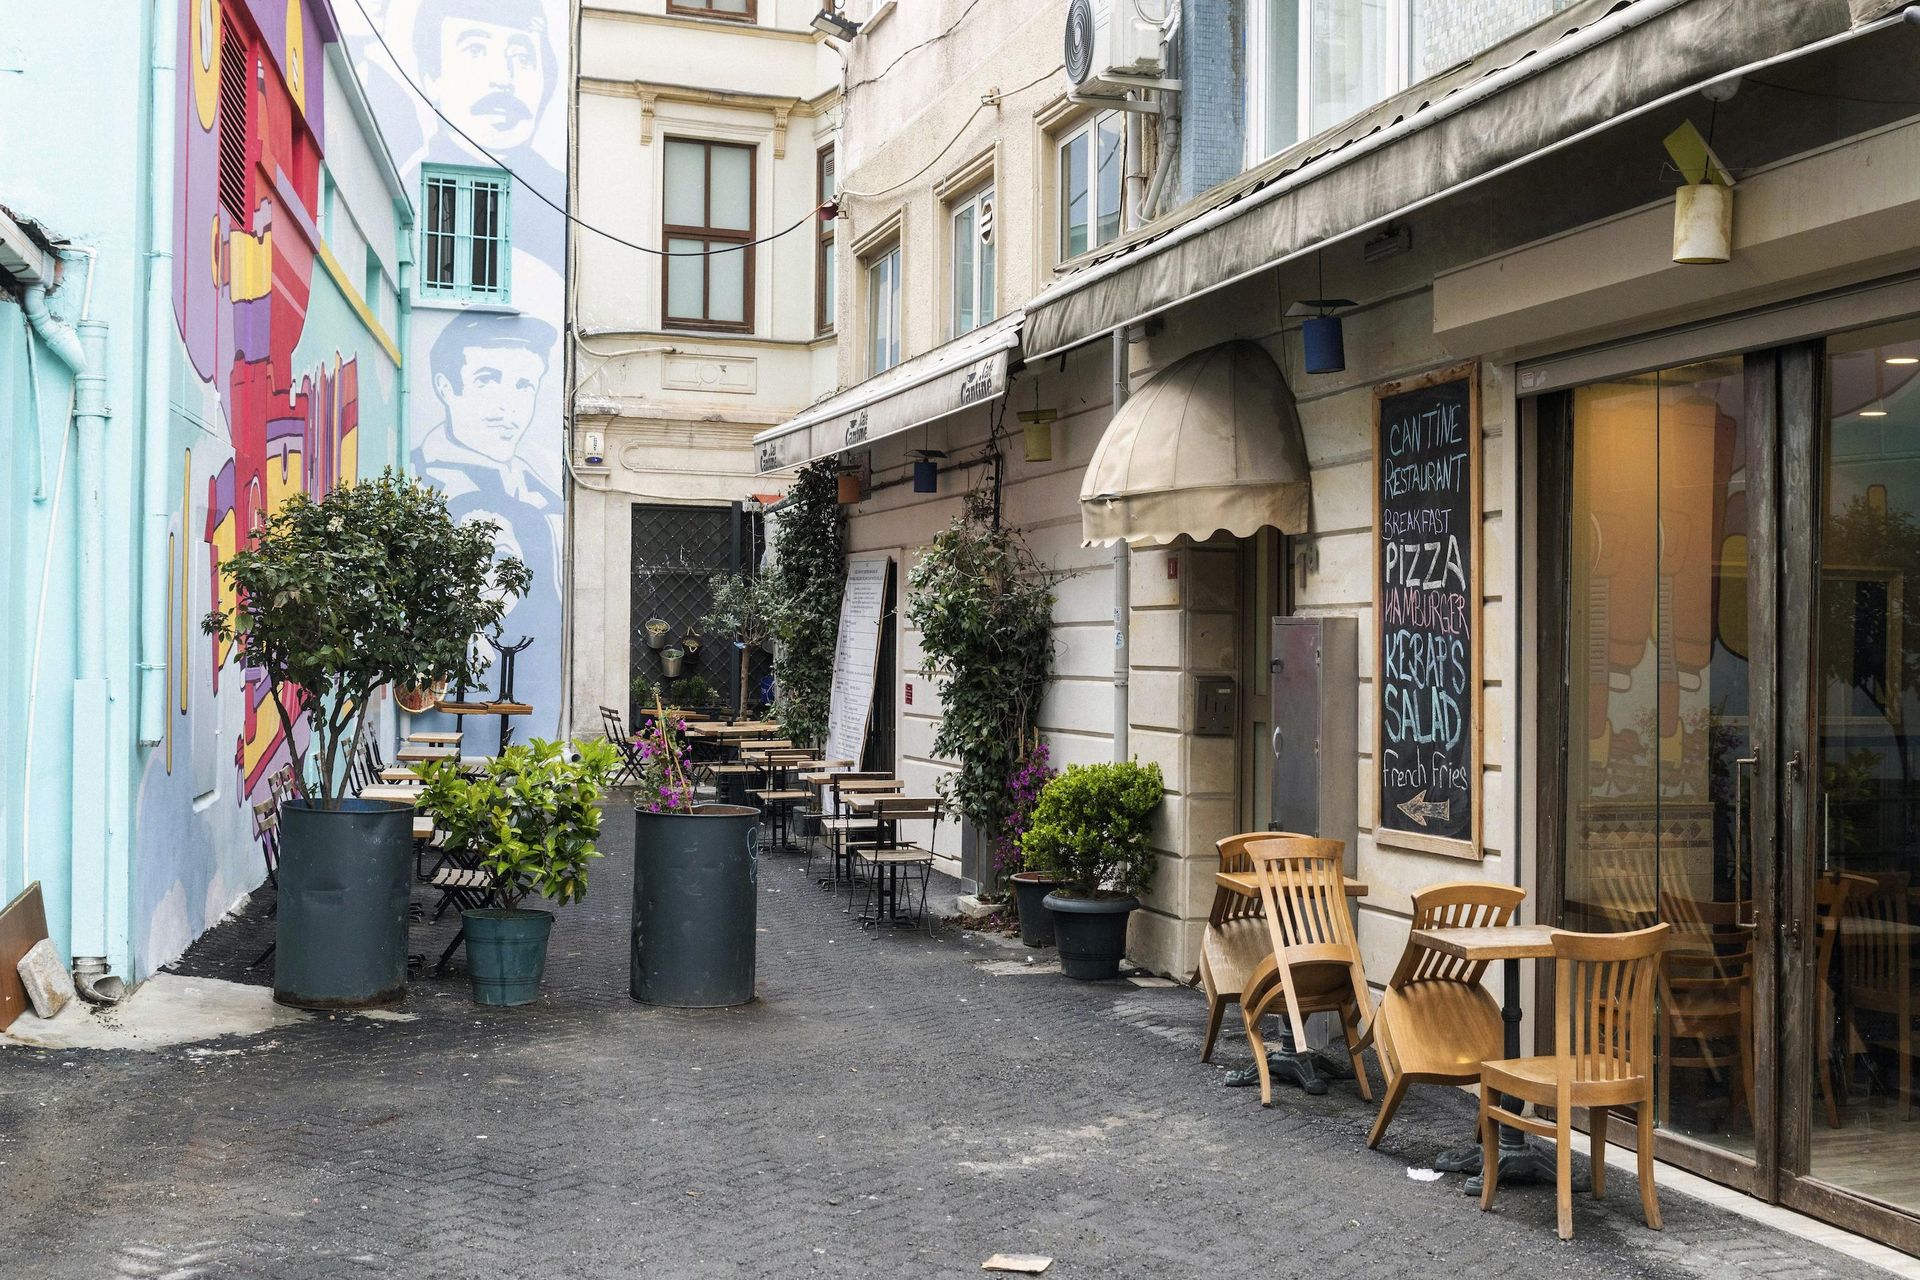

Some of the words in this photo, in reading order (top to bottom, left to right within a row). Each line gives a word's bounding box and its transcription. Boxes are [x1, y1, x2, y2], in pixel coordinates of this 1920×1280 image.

[960, 377, 992, 406] Cantine
[1384, 453, 1467, 501] RESTAURANT
[1382, 508, 1452, 540] BREAKFAST
[1384, 589, 1470, 641] HAMBURGER
[1384, 683, 1462, 752] SALAD
